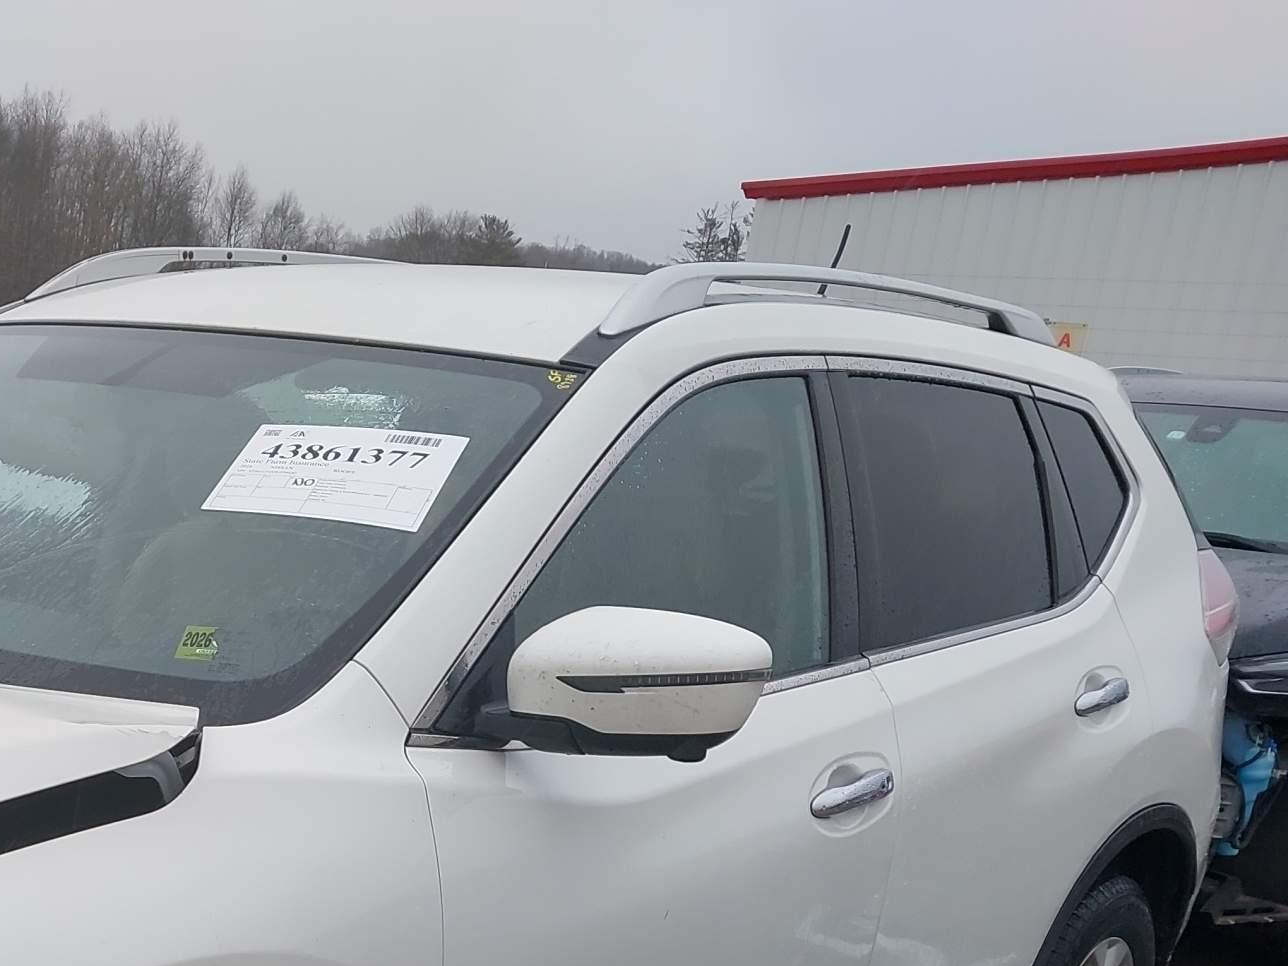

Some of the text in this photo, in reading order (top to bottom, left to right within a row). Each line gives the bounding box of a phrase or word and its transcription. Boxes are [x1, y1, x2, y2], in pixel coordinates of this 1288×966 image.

[1058, 333, 1070, 347] A
[261, 443, 430, 469] 43861377
[289, 459, 330, 467] Insurance
[182, 632, 214, 647] 2026
